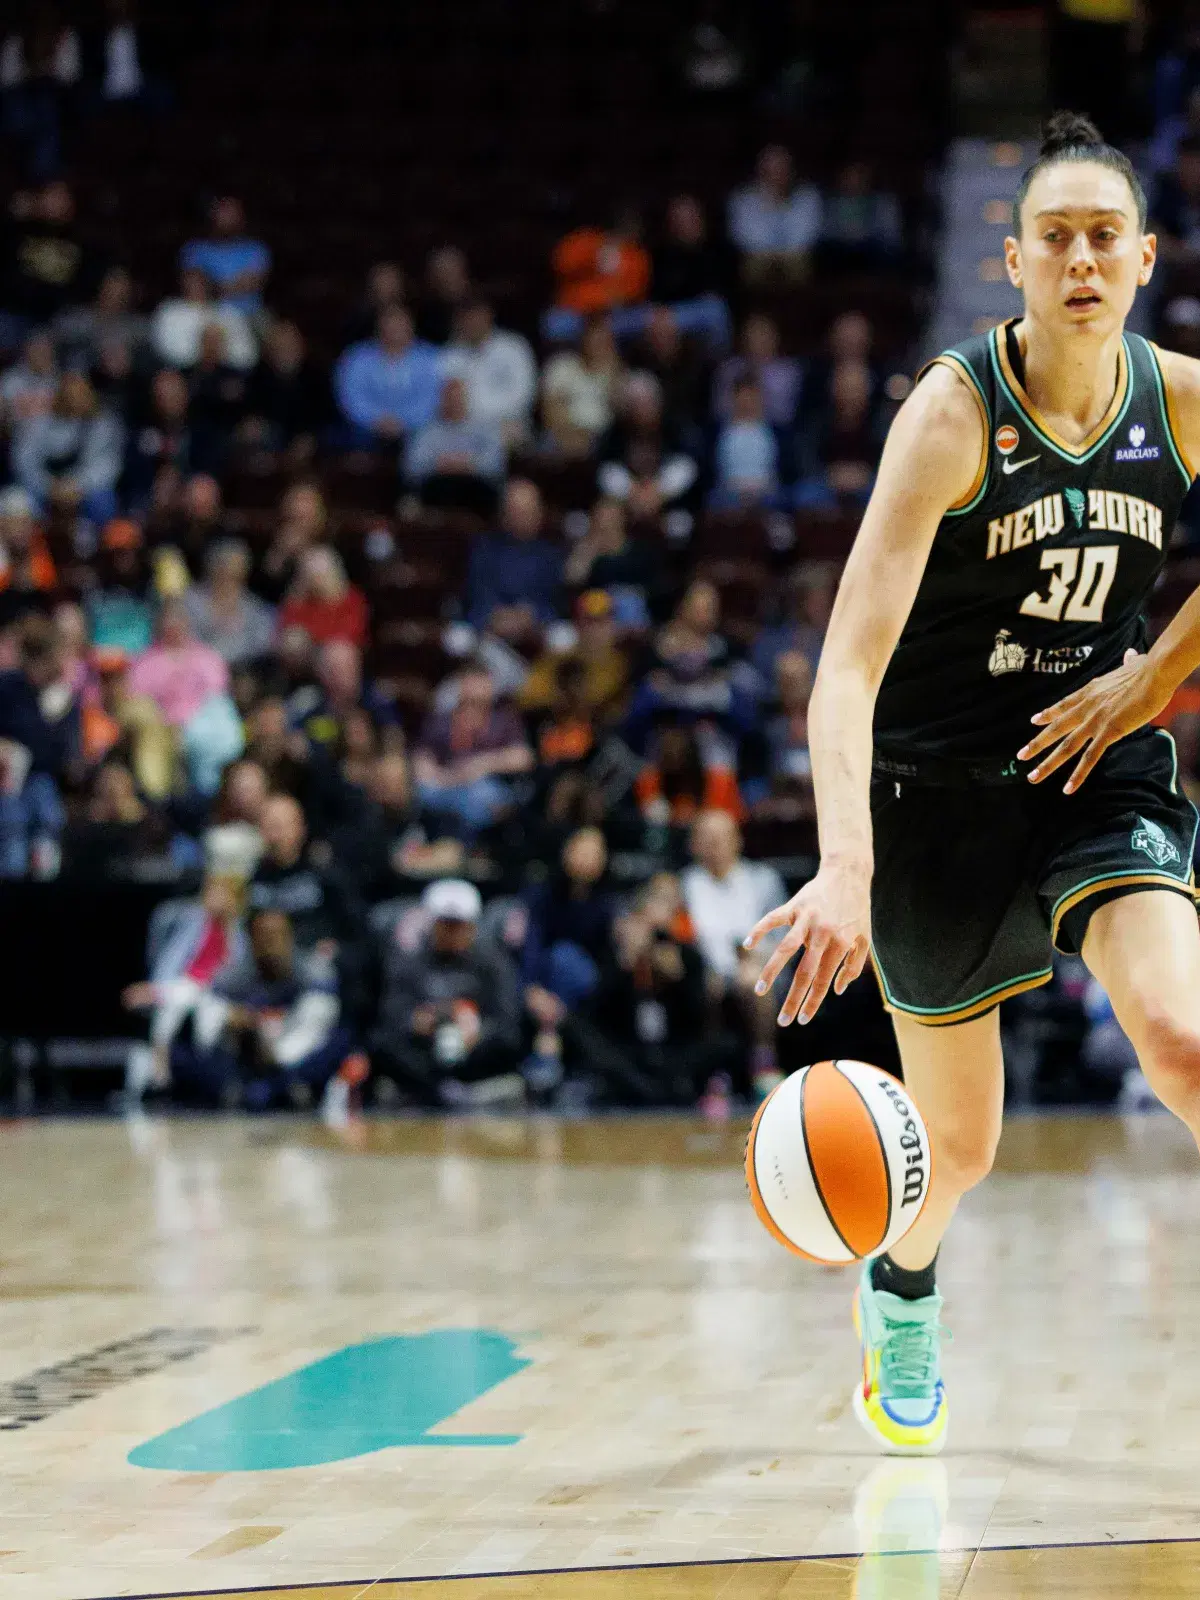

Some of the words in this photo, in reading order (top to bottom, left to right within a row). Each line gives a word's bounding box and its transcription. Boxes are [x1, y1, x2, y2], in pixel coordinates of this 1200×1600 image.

[1115, 446, 1160, 461] BARCLAYS
[986, 493, 1065, 560] NEW
[1088, 489, 1163, 551] YORK
[1019, 545, 1120, 623] 30
[878, 1080, 924, 1208] Wilson
